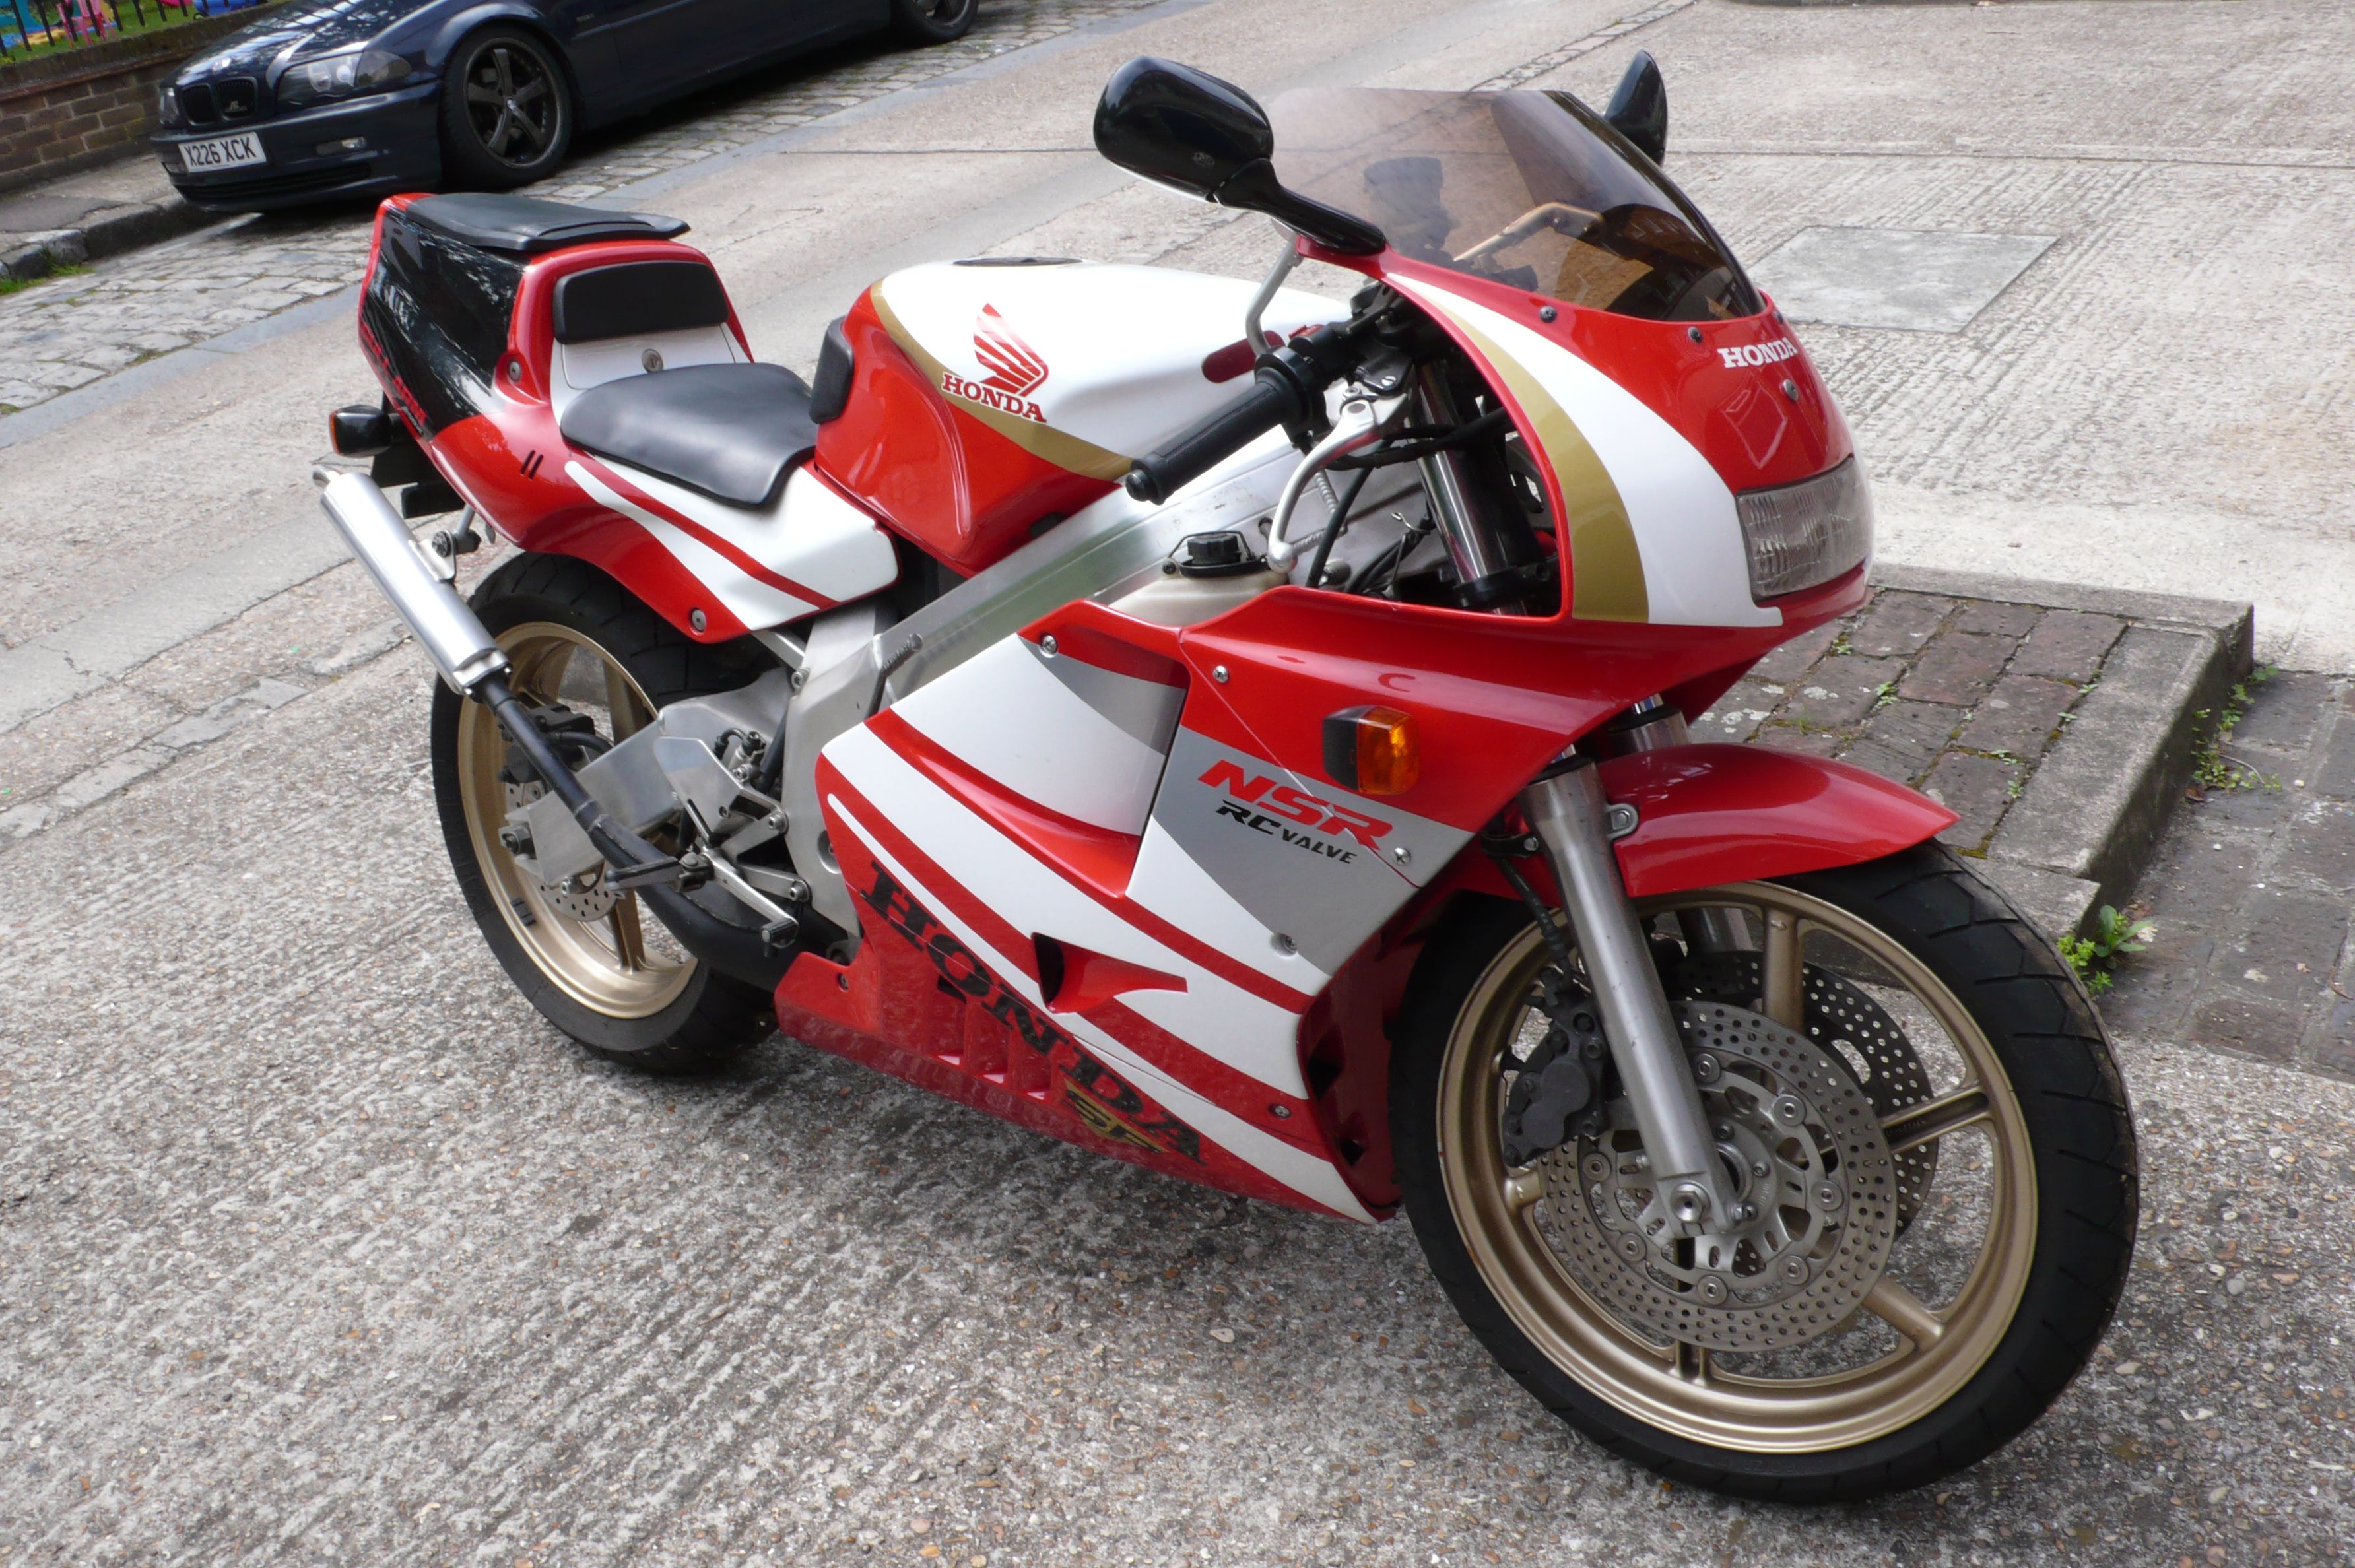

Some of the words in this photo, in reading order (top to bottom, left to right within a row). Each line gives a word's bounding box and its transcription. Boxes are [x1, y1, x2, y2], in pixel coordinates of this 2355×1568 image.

[185, 143, 221, 166] X226
[220, 137, 257, 162] XCK
[1717, 337, 1799, 368] HONDA
[942, 373, 1047, 423] HONDA
[1197, 759, 1393, 851] NSR
[1215, 799, 1282, 835] RC
[1282, 828, 1357, 865] VALVE
[859, 860, 1207, 1167] HONDA
